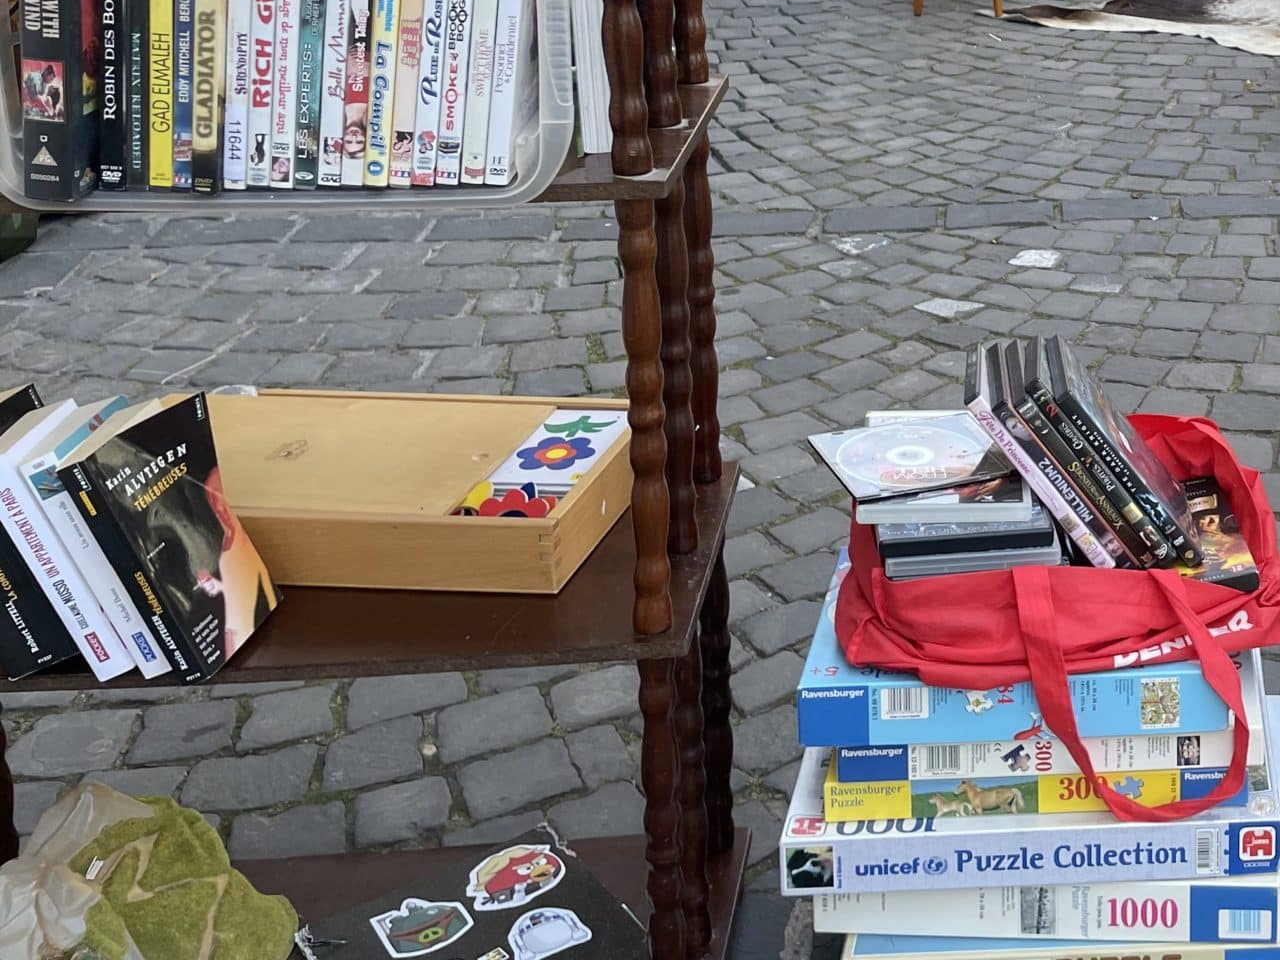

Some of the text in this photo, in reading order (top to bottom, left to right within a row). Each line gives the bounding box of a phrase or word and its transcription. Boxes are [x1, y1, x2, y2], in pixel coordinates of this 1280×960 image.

[40, 0, 60, 39] WITH
[281, 21, 292, 33] de
[103, 29, 114, 59] DES
[178, 30, 190, 75] MITCHELL
[278, 36, 288, 60] mon
[374, 41, 391, 67] La
[503, 14, 517, 76] Confidentiel
[193, 9, 217, 138] GLADIATOR
[234, 32, 250, 94] SERENDIPITY
[352, 41, 365, 91] Sweetest
[419, 54, 440, 105] PLUIE
[494, 43, 506, 93] Personnel
[102, 65, 117, 119] ROBIN
[151, 32, 169, 132] GAD ELMALEH
[178, 79, 188, 102] EDDY
[276, 65, 291, 109] meilleur
[326, 66, 347, 100] Belle
[443, 63, 458, 130] SMOKE
[131, 33, 140, 168] MATRIX RELOADED
[228, 119, 240, 160] 11644
[276, 112, 286, 134] ami
[297, 128, 308, 157] LES
[124, 443, 189, 495] ALVTEGEN
[994, 429, 1008, 443] De
[1002, 439, 1032, 474] Princesse
[1071, 412, 1136, 492] THE DARK KNIGHT
[103, 465, 134, 490] Karin
[133, 462, 188, 512] TÉNÉBREUSES
[1047, 465, 1092, 522] MILLENIUM
[1090, 462, 1115, 491] PIRATES
[0, 486, 20, 512] PARIS
[1094, 493, 1125, 531] ANNEAUX
[15, 517, 48, 566] APPARTEMENT
[43, 563, 59, 579] UN
[53, 580, 75, 606] MUSSO
[5, 602, 24, 630] LITTELL
[151, 615, 176, 650] ALVTEGEN
[21, 626, 39, 654] Robert
[172, 649, 189, 671] Karin
[801, 689, 864, 700] Ravensburger
[841, 748, 903, 758] Ravensburger
[1035, 740, 1053, 773] 300
[830, 784, 904, 797] Ravensburger
[830, 796, 865, 808] Puzzle
[855, 857, 921, 876] unicef
[954, 844, 1045, 873] Puzzle
[1053, 841, 1188, 871] Collection
[1106, 897, 1180, 929] 1000
